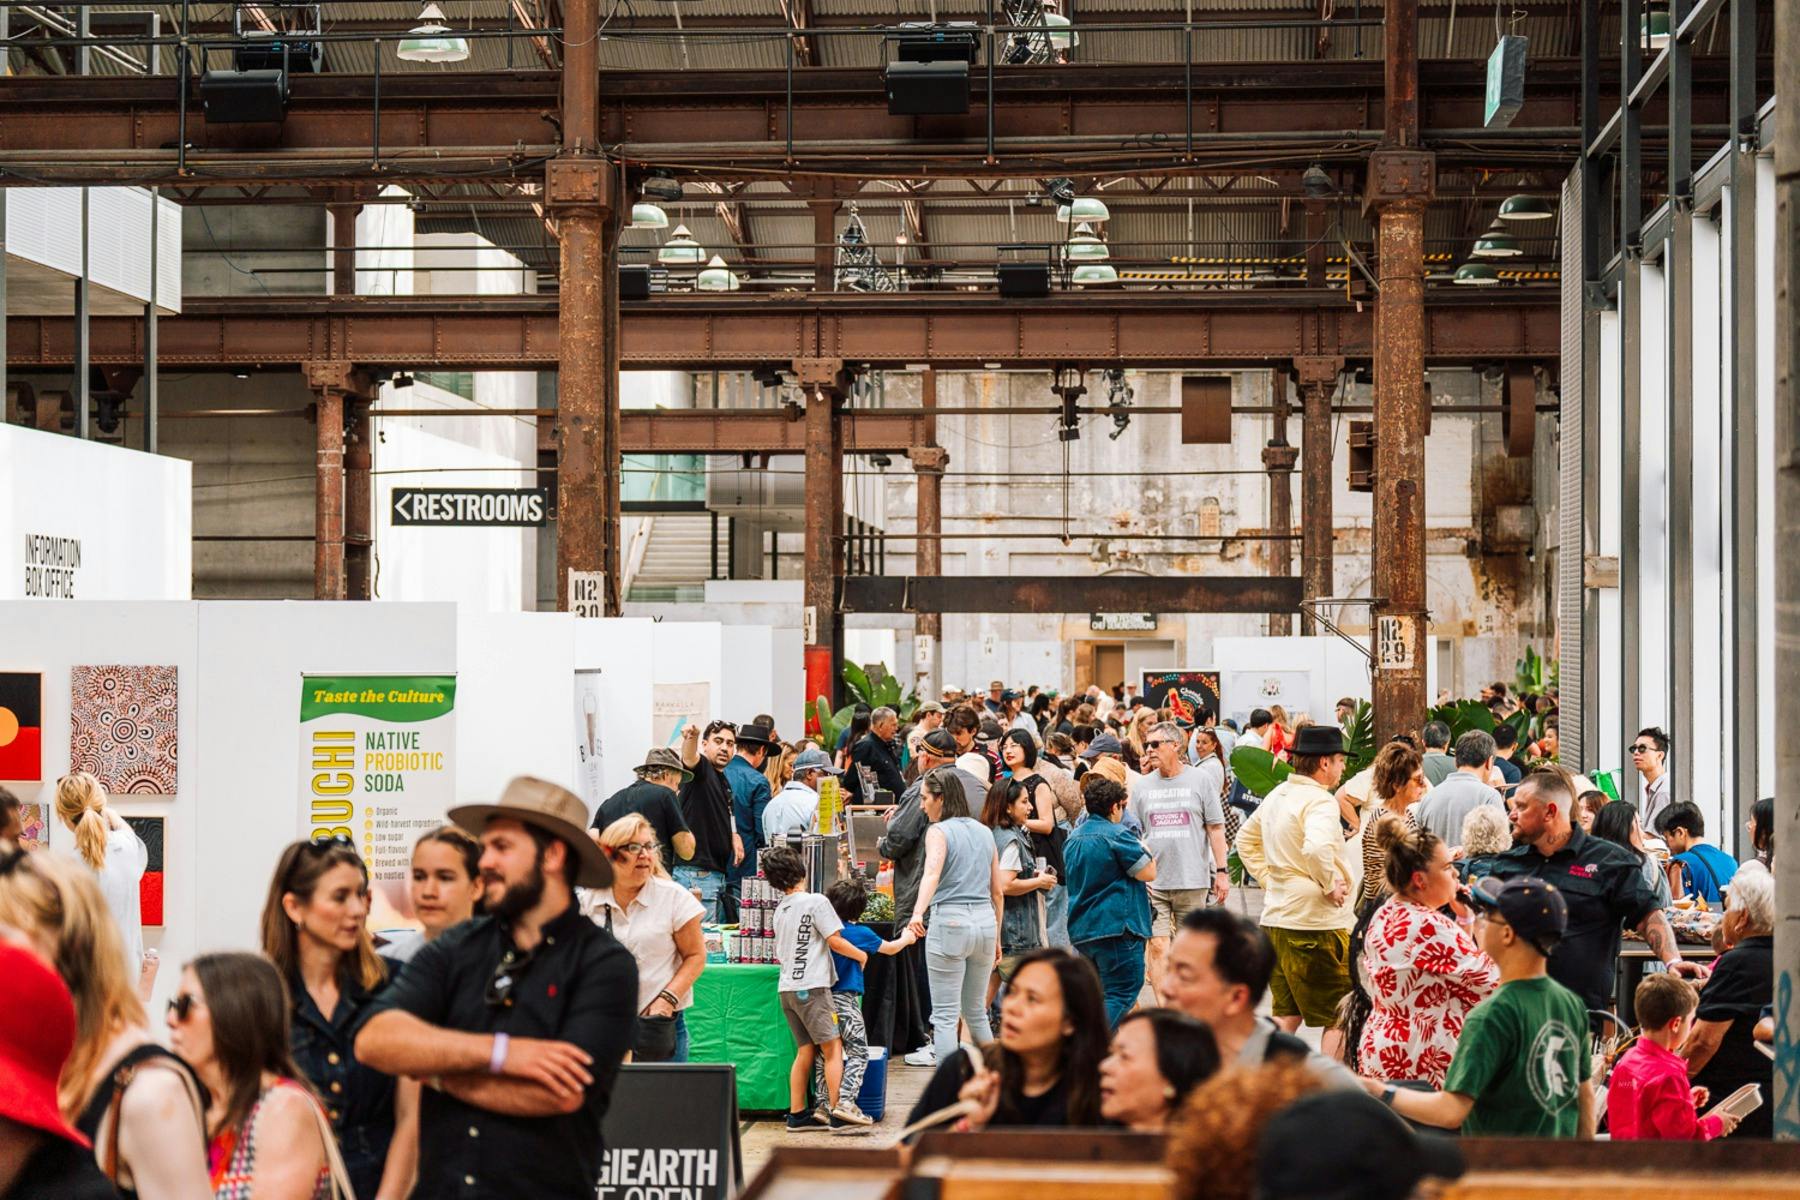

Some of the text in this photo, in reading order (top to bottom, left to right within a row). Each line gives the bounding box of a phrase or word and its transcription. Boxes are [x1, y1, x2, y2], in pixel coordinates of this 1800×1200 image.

[413, 494, 543, 521] RESTROOMS
[25, 534, 81, 568] INFORMATION
[26, 566, 74, 599] BOX OFFICE
[1381, 642, 1406, 663] 29
[313, 689, 445, 703] Taste the Culture
[366, 732, 420, 750] NATIVE
[365, 752, 443, 771] PROBIOTIC
[364, 774, 404, 792] SODA
[1148, 788, 1191, 799] EDUCATION
[376, 807, 398, 816] Organic
[375, 833, 404, 843] Low sugar
[375, 858, 397, 868] Brewed
[375, 871, 405, 880] No nasties
[792, 913, 812, 980] GUNNERS
